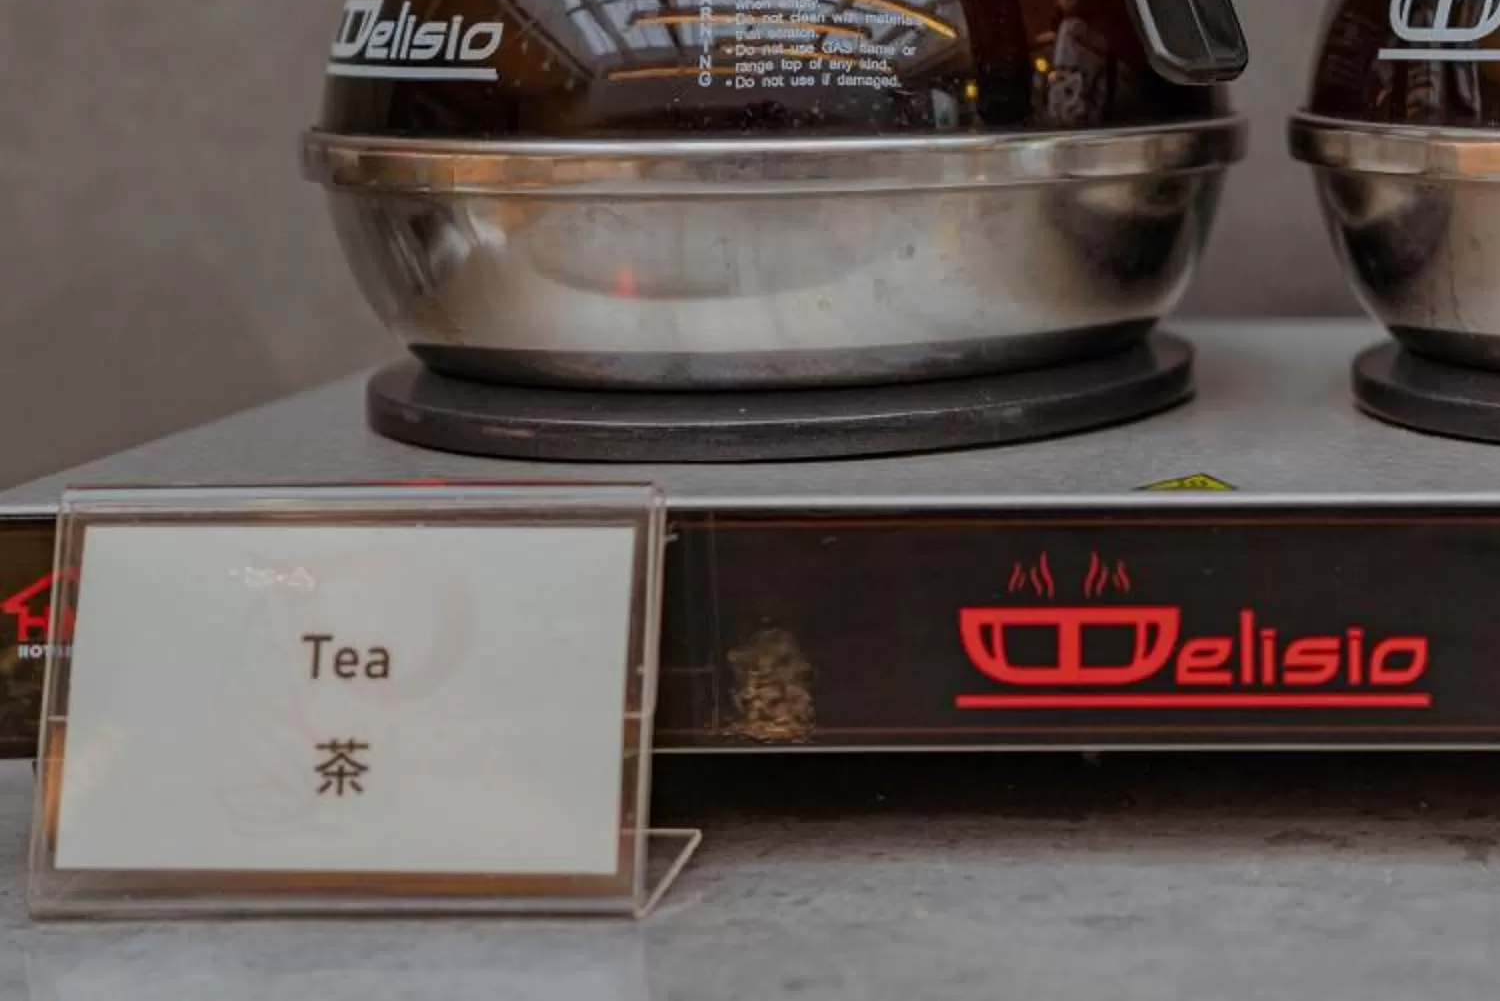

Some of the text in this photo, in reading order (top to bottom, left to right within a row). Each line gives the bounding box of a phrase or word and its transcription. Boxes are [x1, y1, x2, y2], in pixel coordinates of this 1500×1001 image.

[736, 44, 756, 57] Do
[762, 44, 785, 55] not
[736, 61, 774, 74] range
[781, 59, 803, 73] top
[809, 58, 822, 70] of
[736, 75, 755, 89] Do
[762, 75, 785, 87] not
[790, 76, 815, 87] use
[302, 633, 391, 681] Tea
[959, 607, 1430, 685] Delisio
[314, 738, 370, 797] 茶
